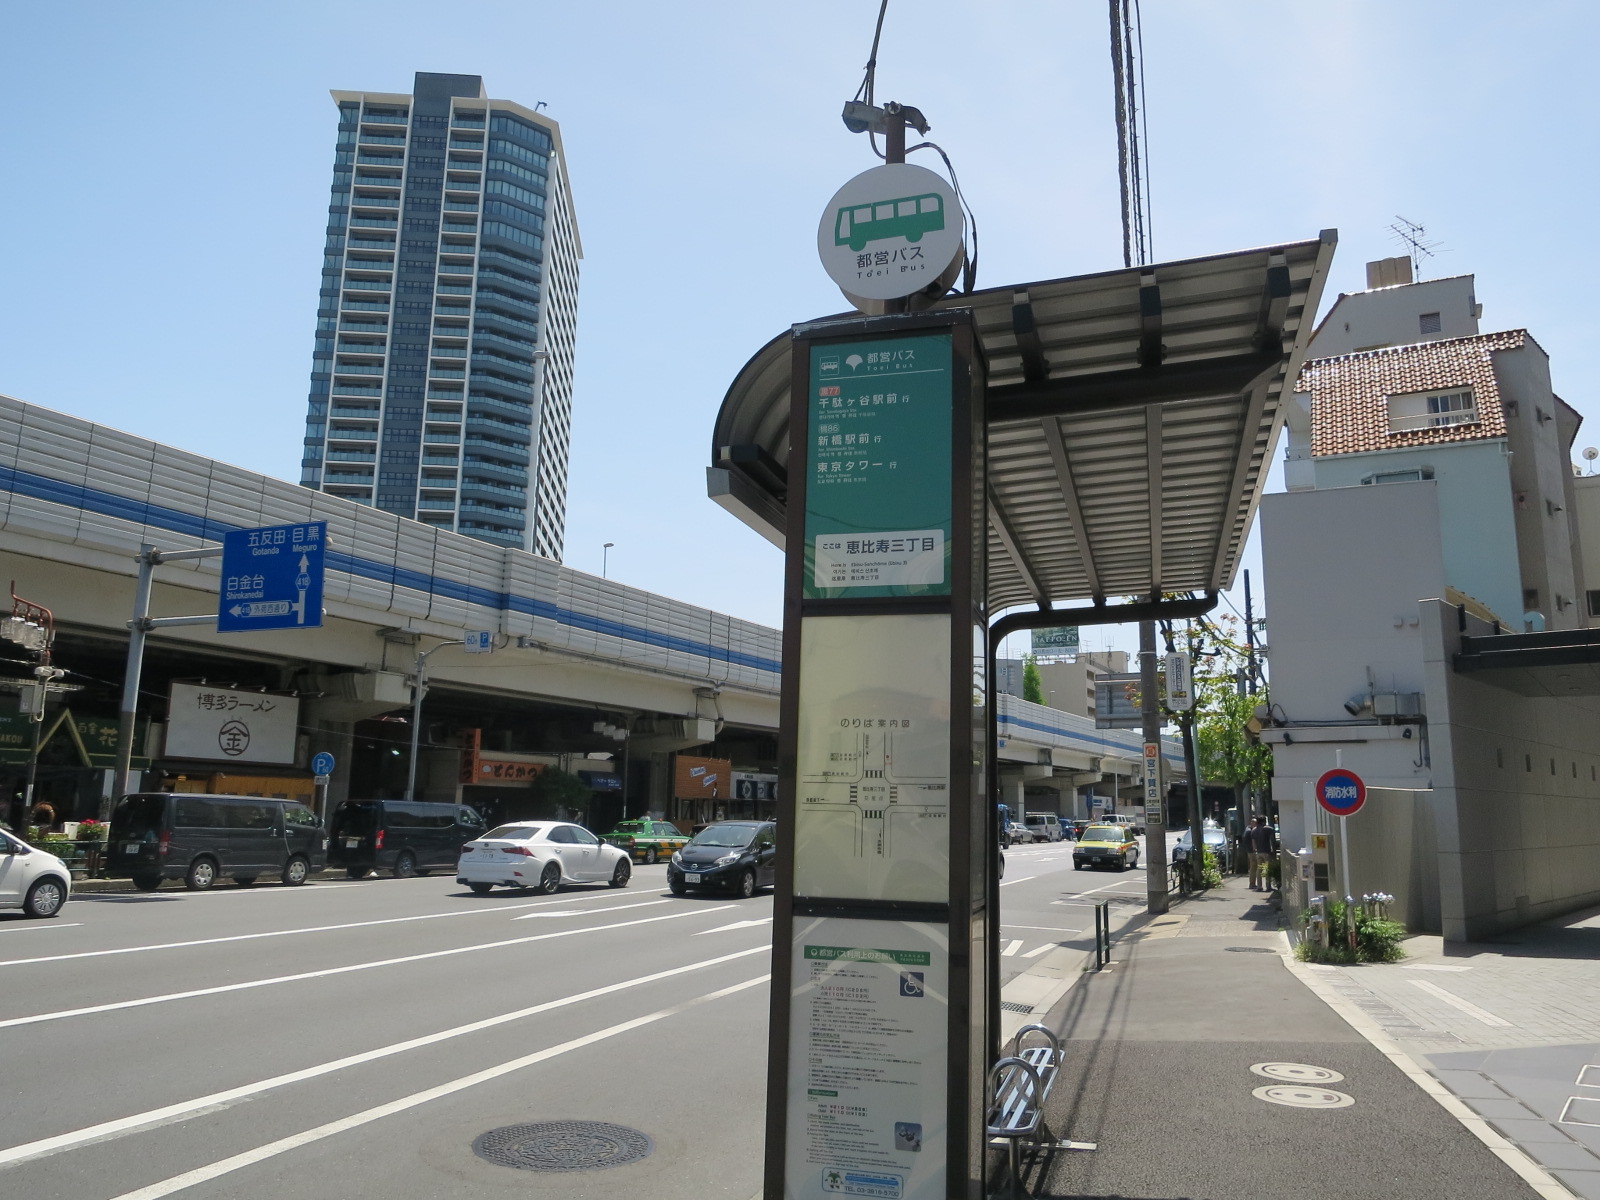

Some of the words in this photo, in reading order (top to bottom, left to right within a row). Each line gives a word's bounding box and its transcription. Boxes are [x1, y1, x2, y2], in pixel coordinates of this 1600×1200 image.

[857, 246, 924, 269] 都営バス
[857, 270, 889, 279] Toei
[901, 264, 925, 272] Bus
[867, 350, 915, 364] 都営バス
[818, 433, 869, 446] 新橋駅前
[817, 460, 883, 473] 東京タワー
[252, 546, 279, 556] Gotanda
[293, 544, 317, 553] Meguro
[846, 538, 934, 554] 恵比寿三丁目
[227, 574, 265, 591] 白金台
[226, 590, 264, 600] Shirokanedai
[198, 693, 276, 712] 博多ラーメン
[840, 718, 910, 728] のりば案内図
[316, 759, 325, 773] P
[493, 765, 537, 778] とんかつ
[1147, 760, 1157, 797] 宮下質店
[1325, 786, 1357, 798] 消防水利
